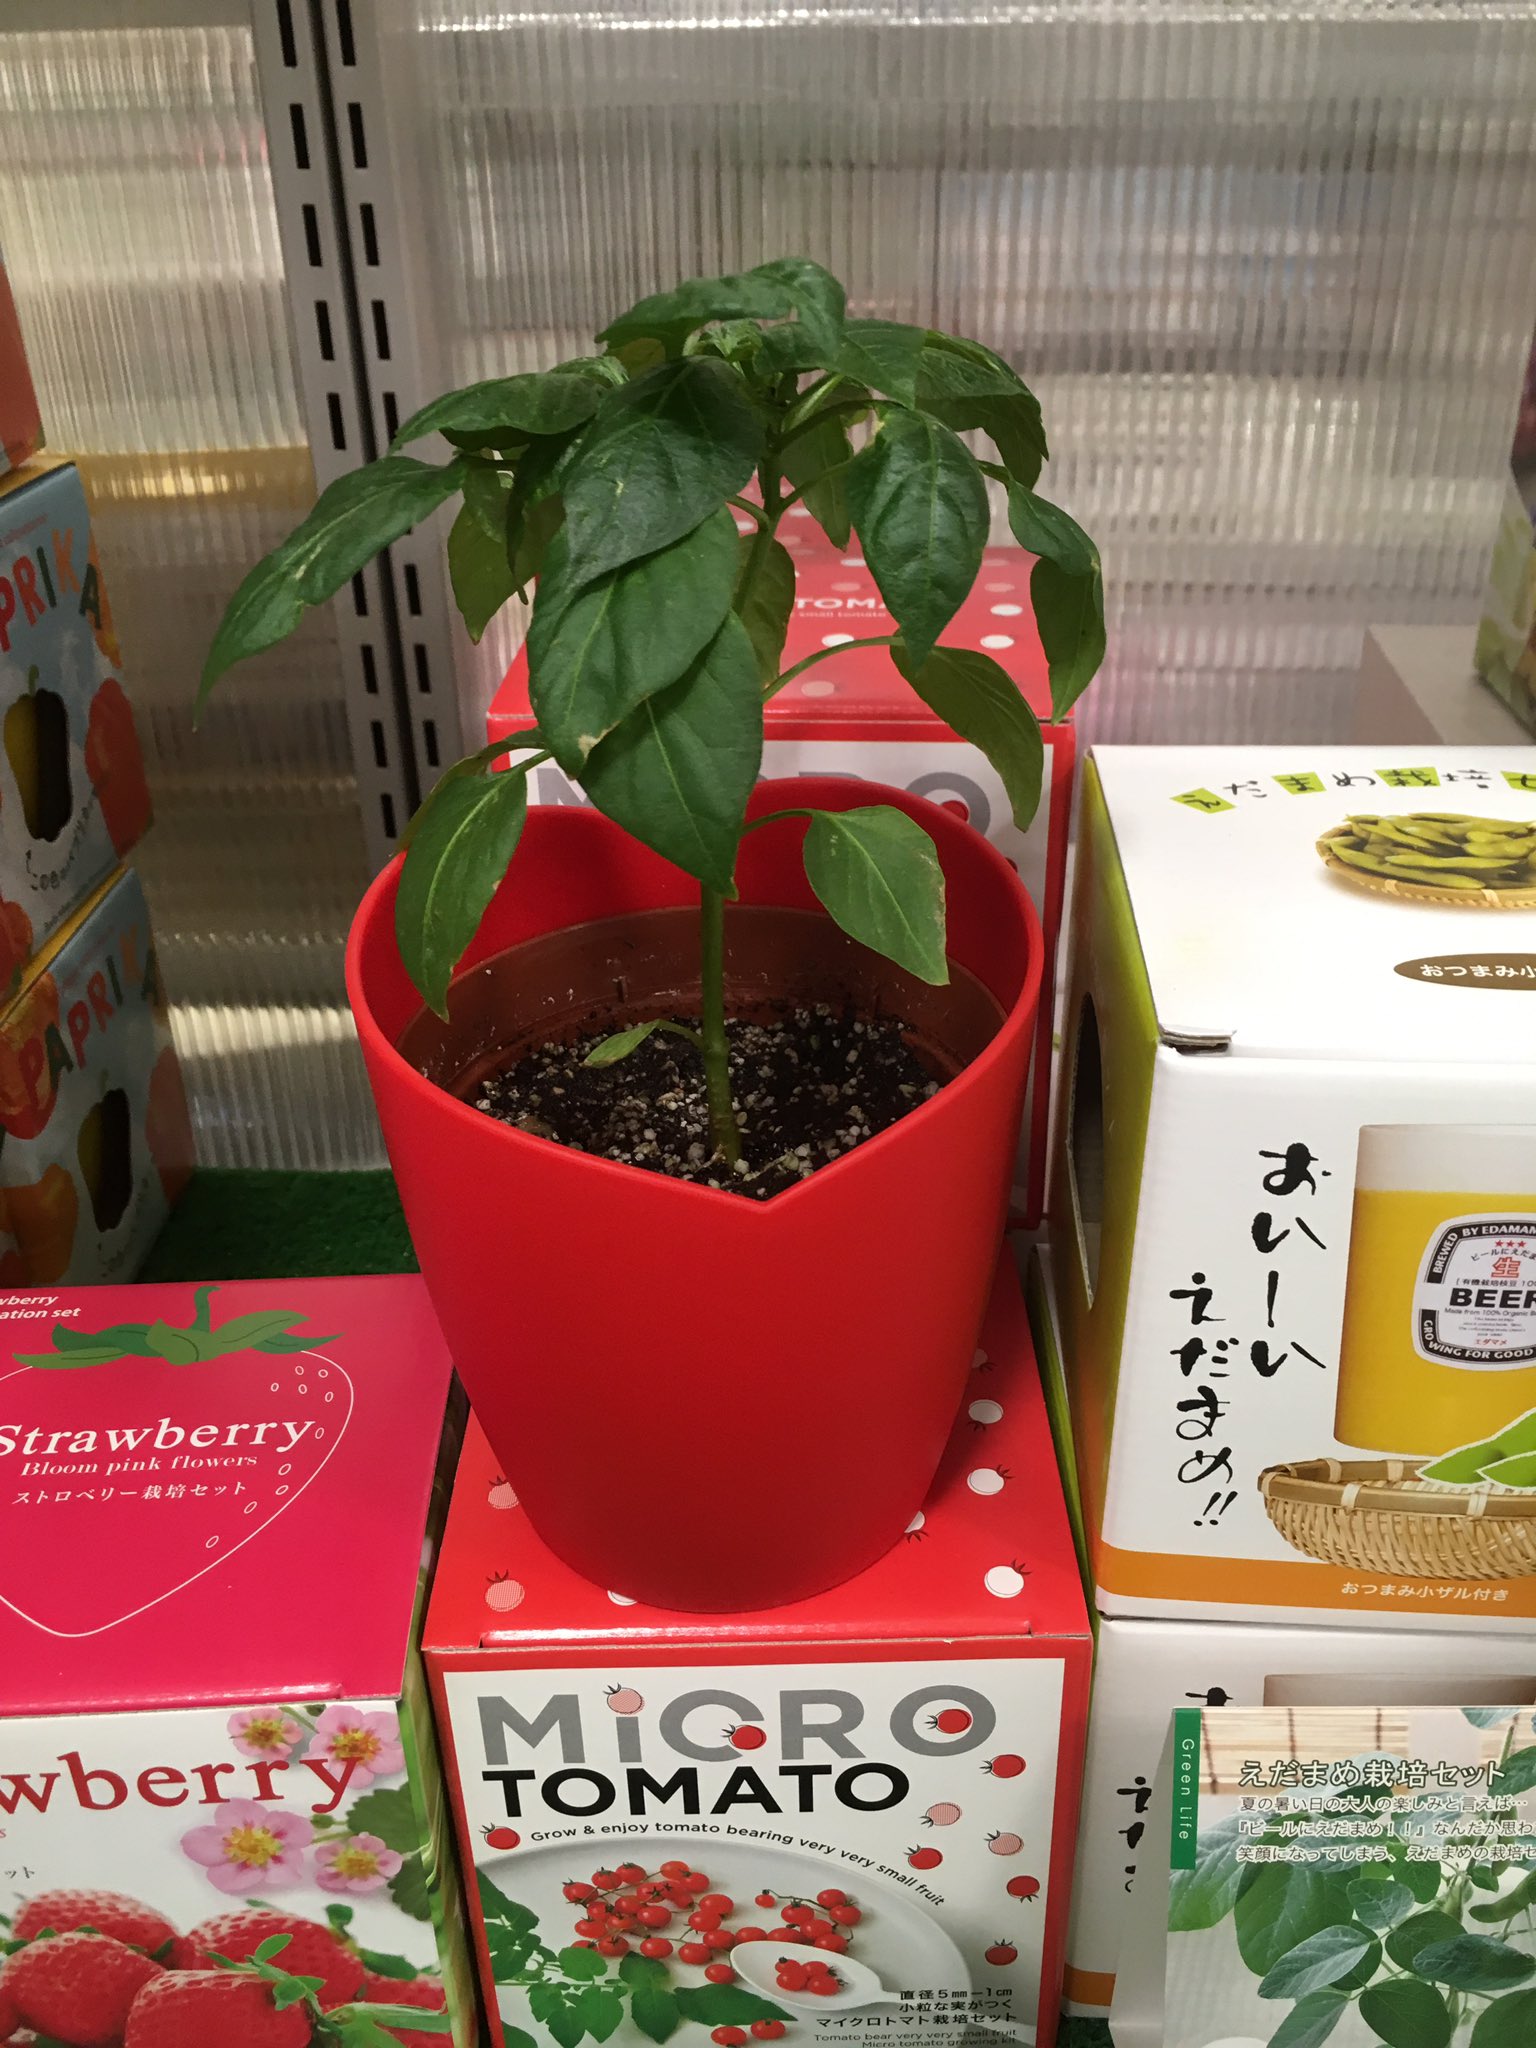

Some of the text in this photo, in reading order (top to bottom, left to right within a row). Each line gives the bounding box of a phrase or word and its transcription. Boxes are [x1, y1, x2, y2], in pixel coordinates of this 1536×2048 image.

[1432, 1232, 1459, 1274] BREWED
[1462, 1226, 1479, 1237] BY
[1490, 1256, 1522, 1279] 生
[51, 1308, 81, 1318] set
[1465, 1349, 1491, 1359] FOR
[1494, 1349, 1534, 1359] GOOD
[20, 1453, 259, 1478] Bloom pink flowers
[12, 1480, 247, 1506] ストロベリー栽培セット
[1341, 1582, 1509, 1602] おつまみ小ザル付き
[1238, 1759, 1506, 1788] えだまめ栽培セット
[482, 1762, 910, 1818] TOMATO
[1178, 1738, 1195, 1840] Green Life
[530, 1822, 945, 1906] Grow & enjoy tomato bearing very very small fruit
[898, 2000, 1012, 2013] 小粒な実がつく
[816, 2013, 1017, 2028] マイクロトマト栽培セット
[814, 2028, 1017, 2042] Tomato bear very very small fruit
[862, 2036, 1016, 2048] Micro tomato growing kit
